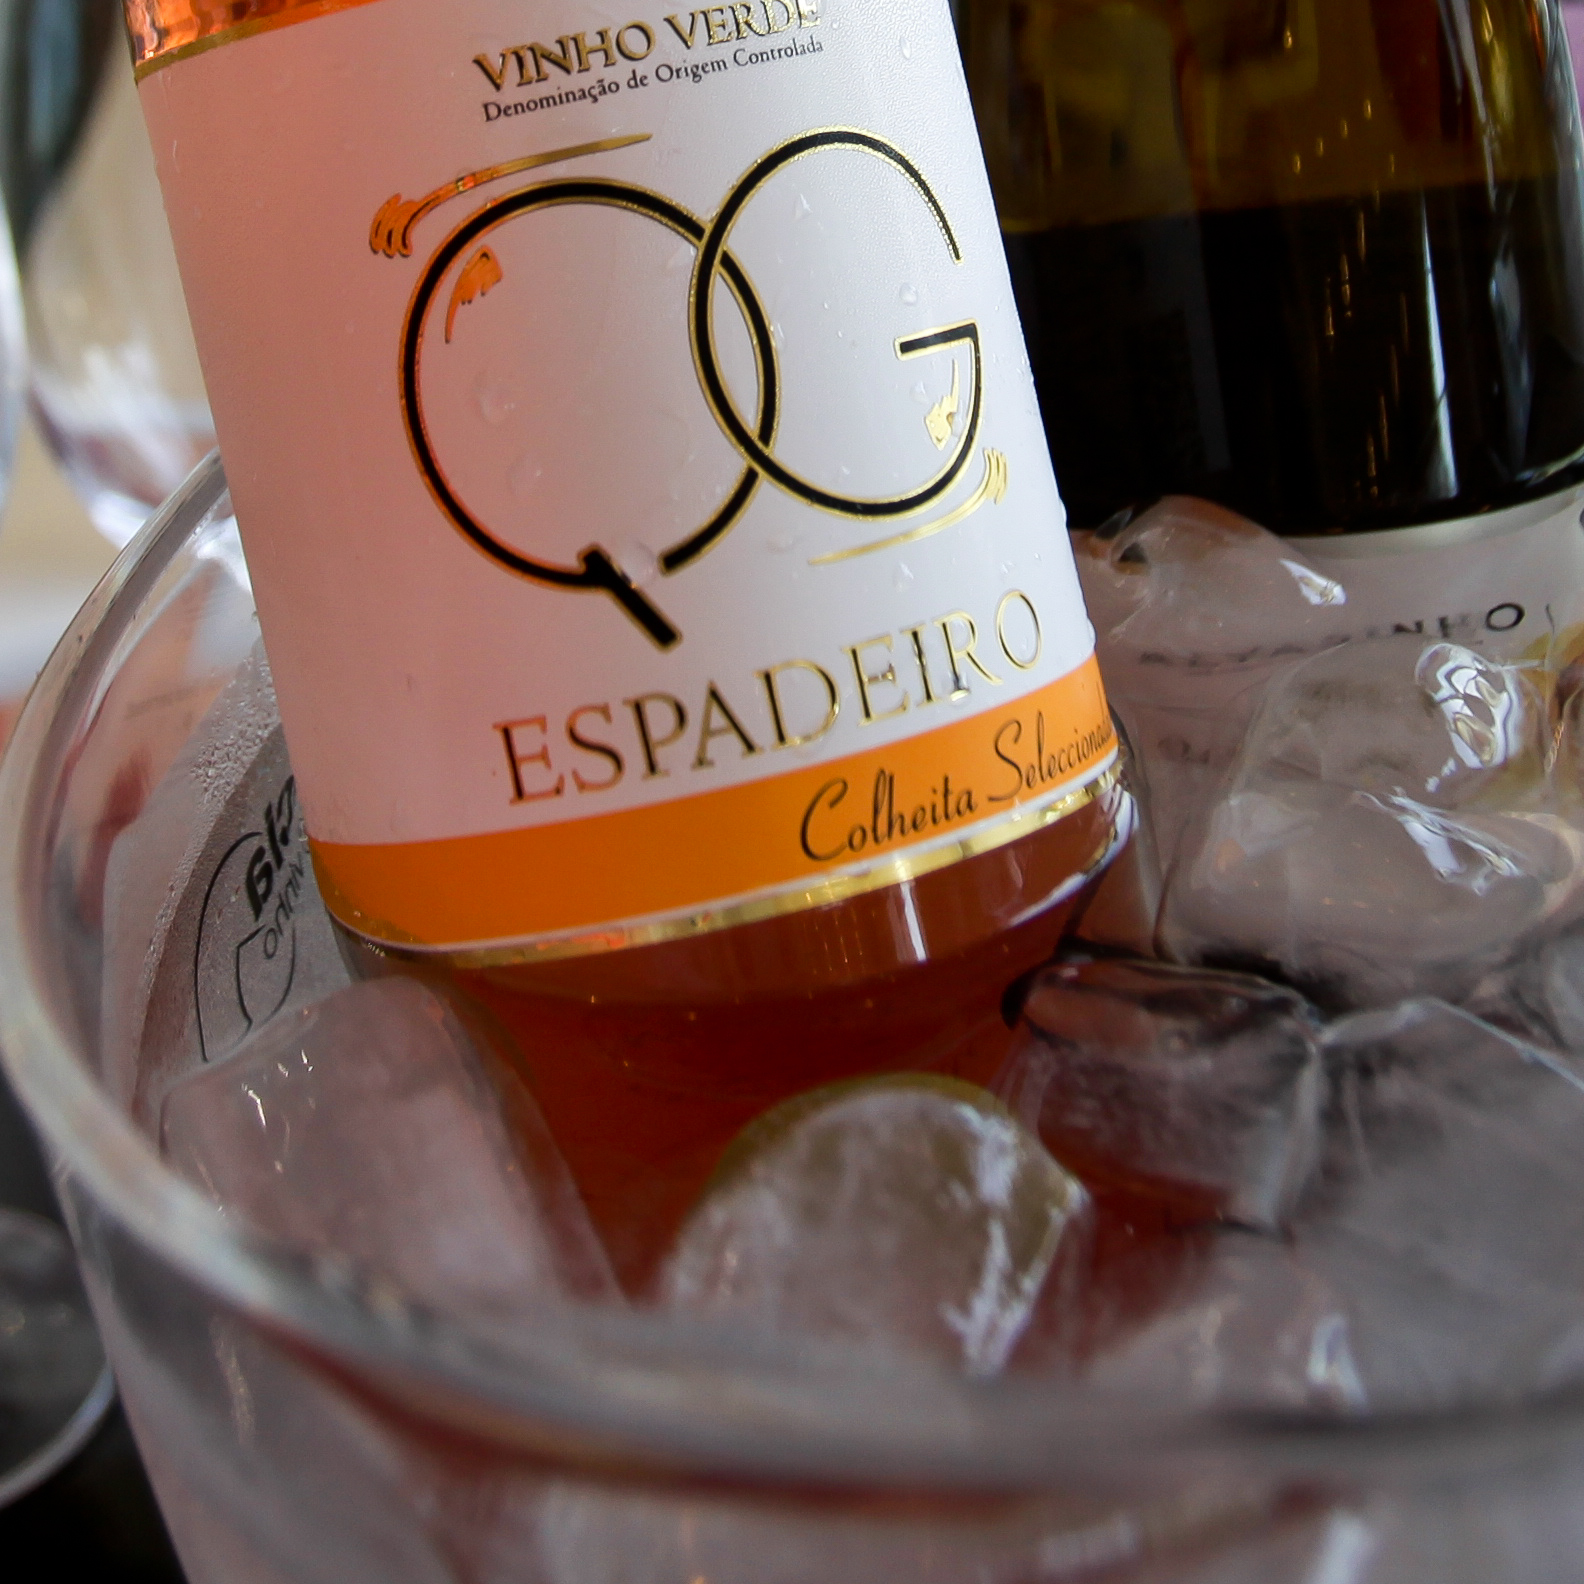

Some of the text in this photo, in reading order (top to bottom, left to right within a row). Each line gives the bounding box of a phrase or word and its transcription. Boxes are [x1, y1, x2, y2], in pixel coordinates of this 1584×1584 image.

[472, 20, 656, 92] VINHO
[482, 35, 824, 122] Denominação de Origem Controlada
[398, 125, 984, 652] QG
[492, 588, 1044, 807] ESPADEIRO
[799, 767, 978, 862] Colheita
